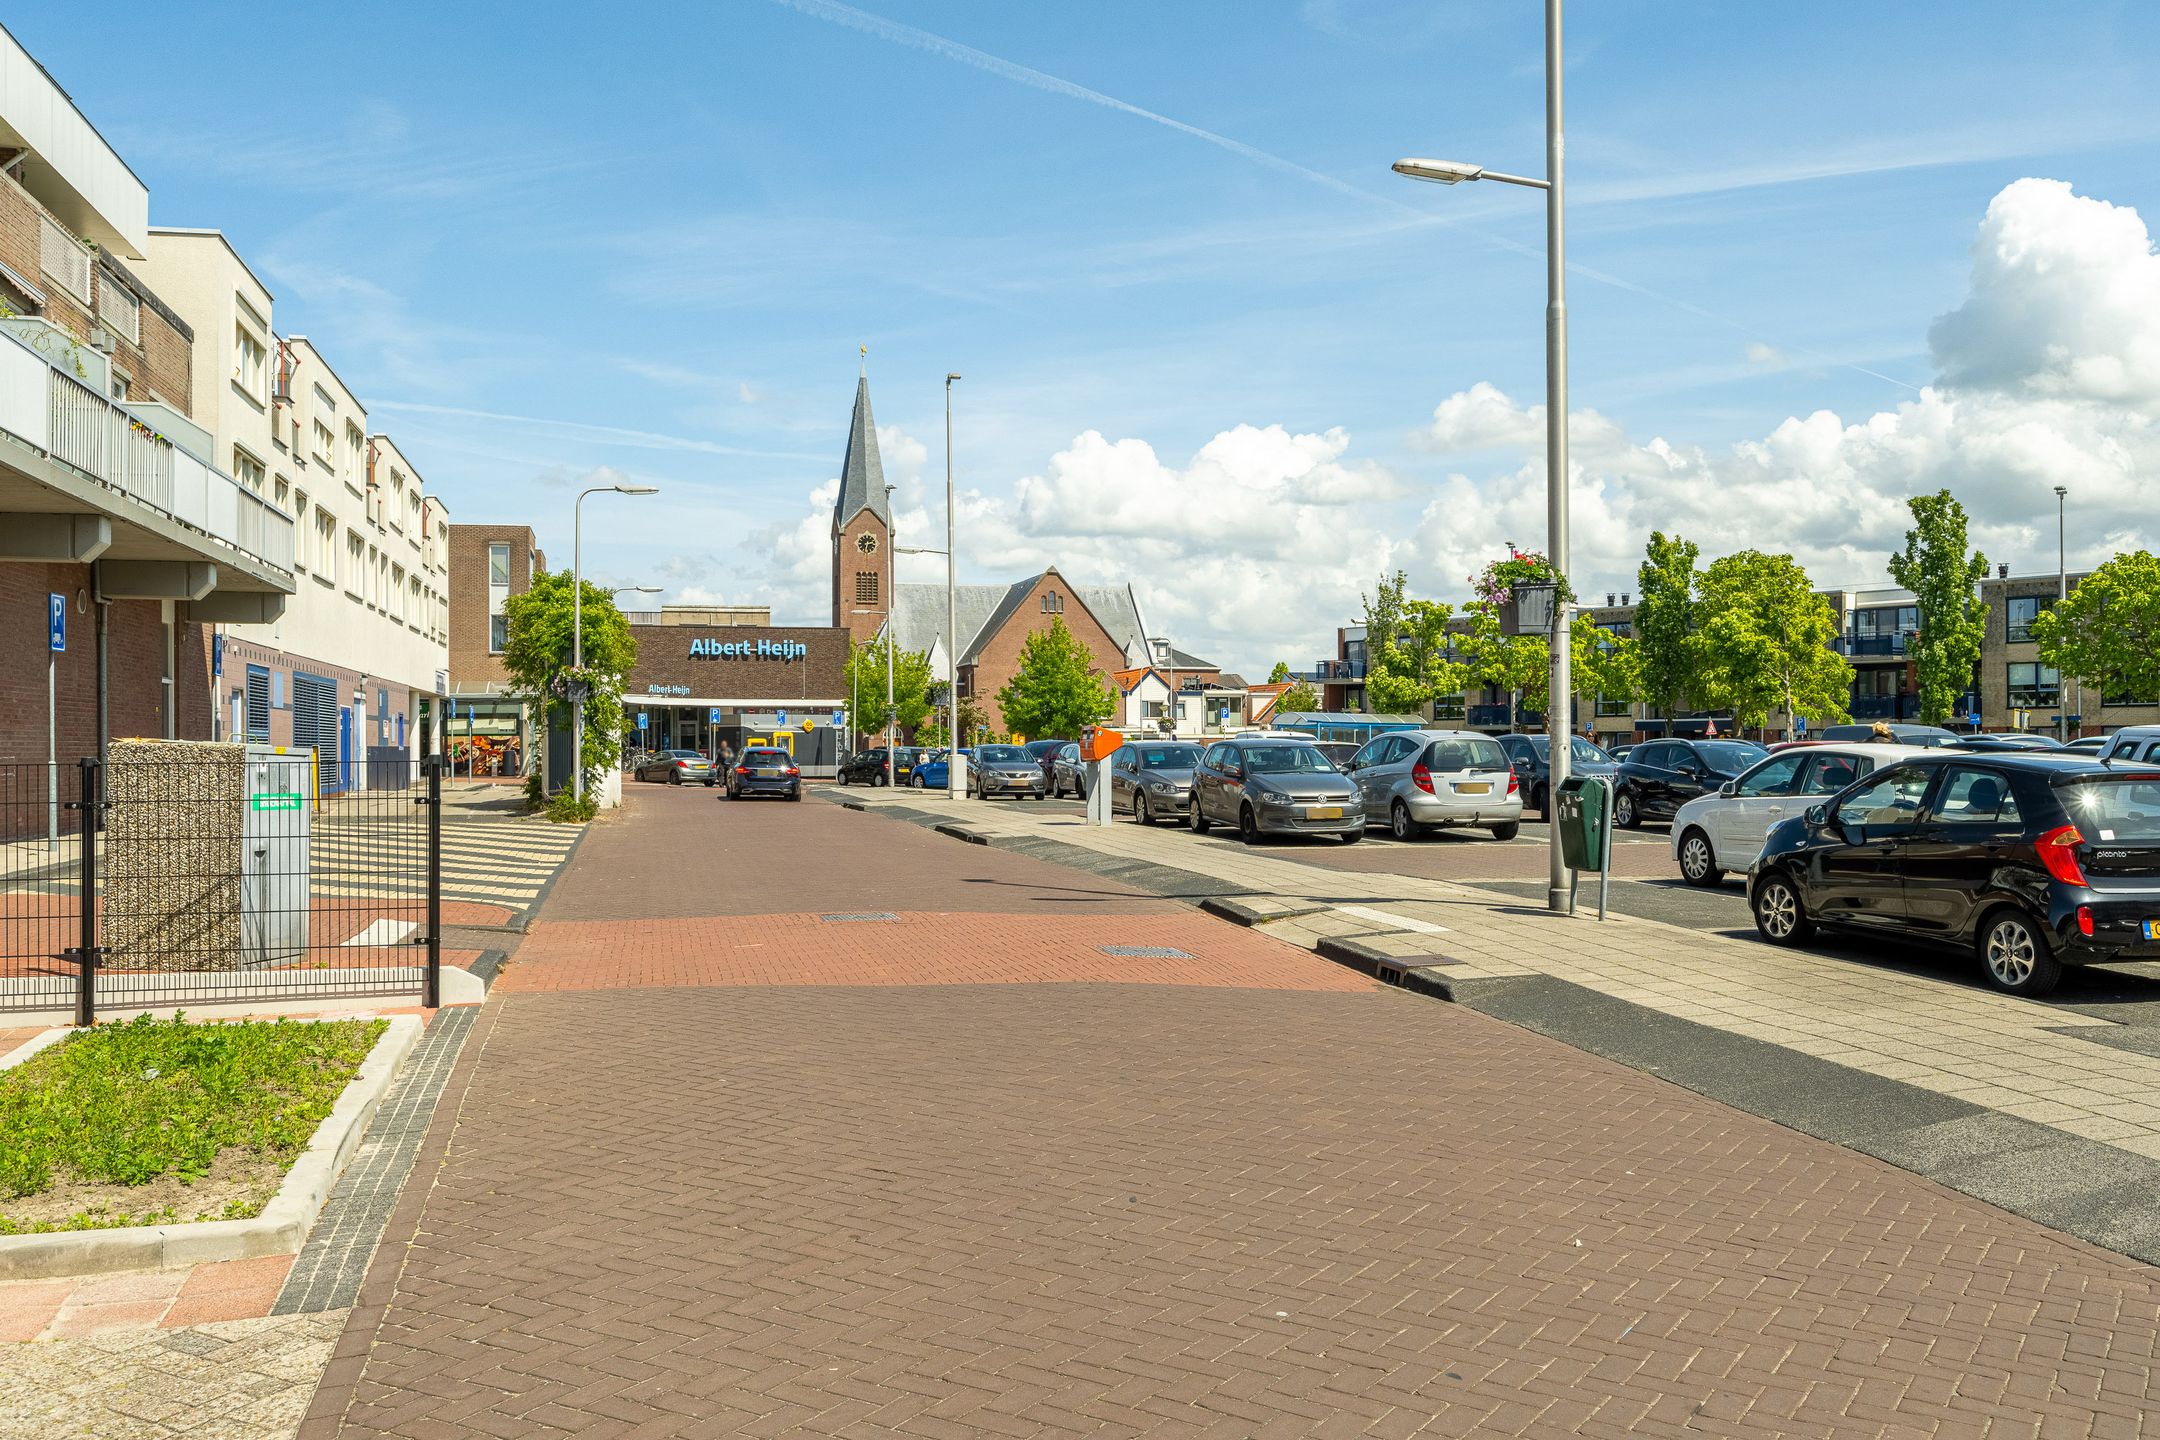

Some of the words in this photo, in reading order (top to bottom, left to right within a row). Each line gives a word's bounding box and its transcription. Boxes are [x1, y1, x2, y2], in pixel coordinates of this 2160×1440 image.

[54, 598, 62, 627] P
[689, 638, 750, 656] Albert
[757, 639, 806, 659] Heijn
[649, 684, 672, 694] Albert
[672, 685, 690, 695] Heijn
[713, 709, 718, 718] P
[1223, 709, 1228, 718] P
[640, 715, 646, 723] P
[1798, 718, 1804, 726] P
[2097, 850, 2127, 860] picanto
